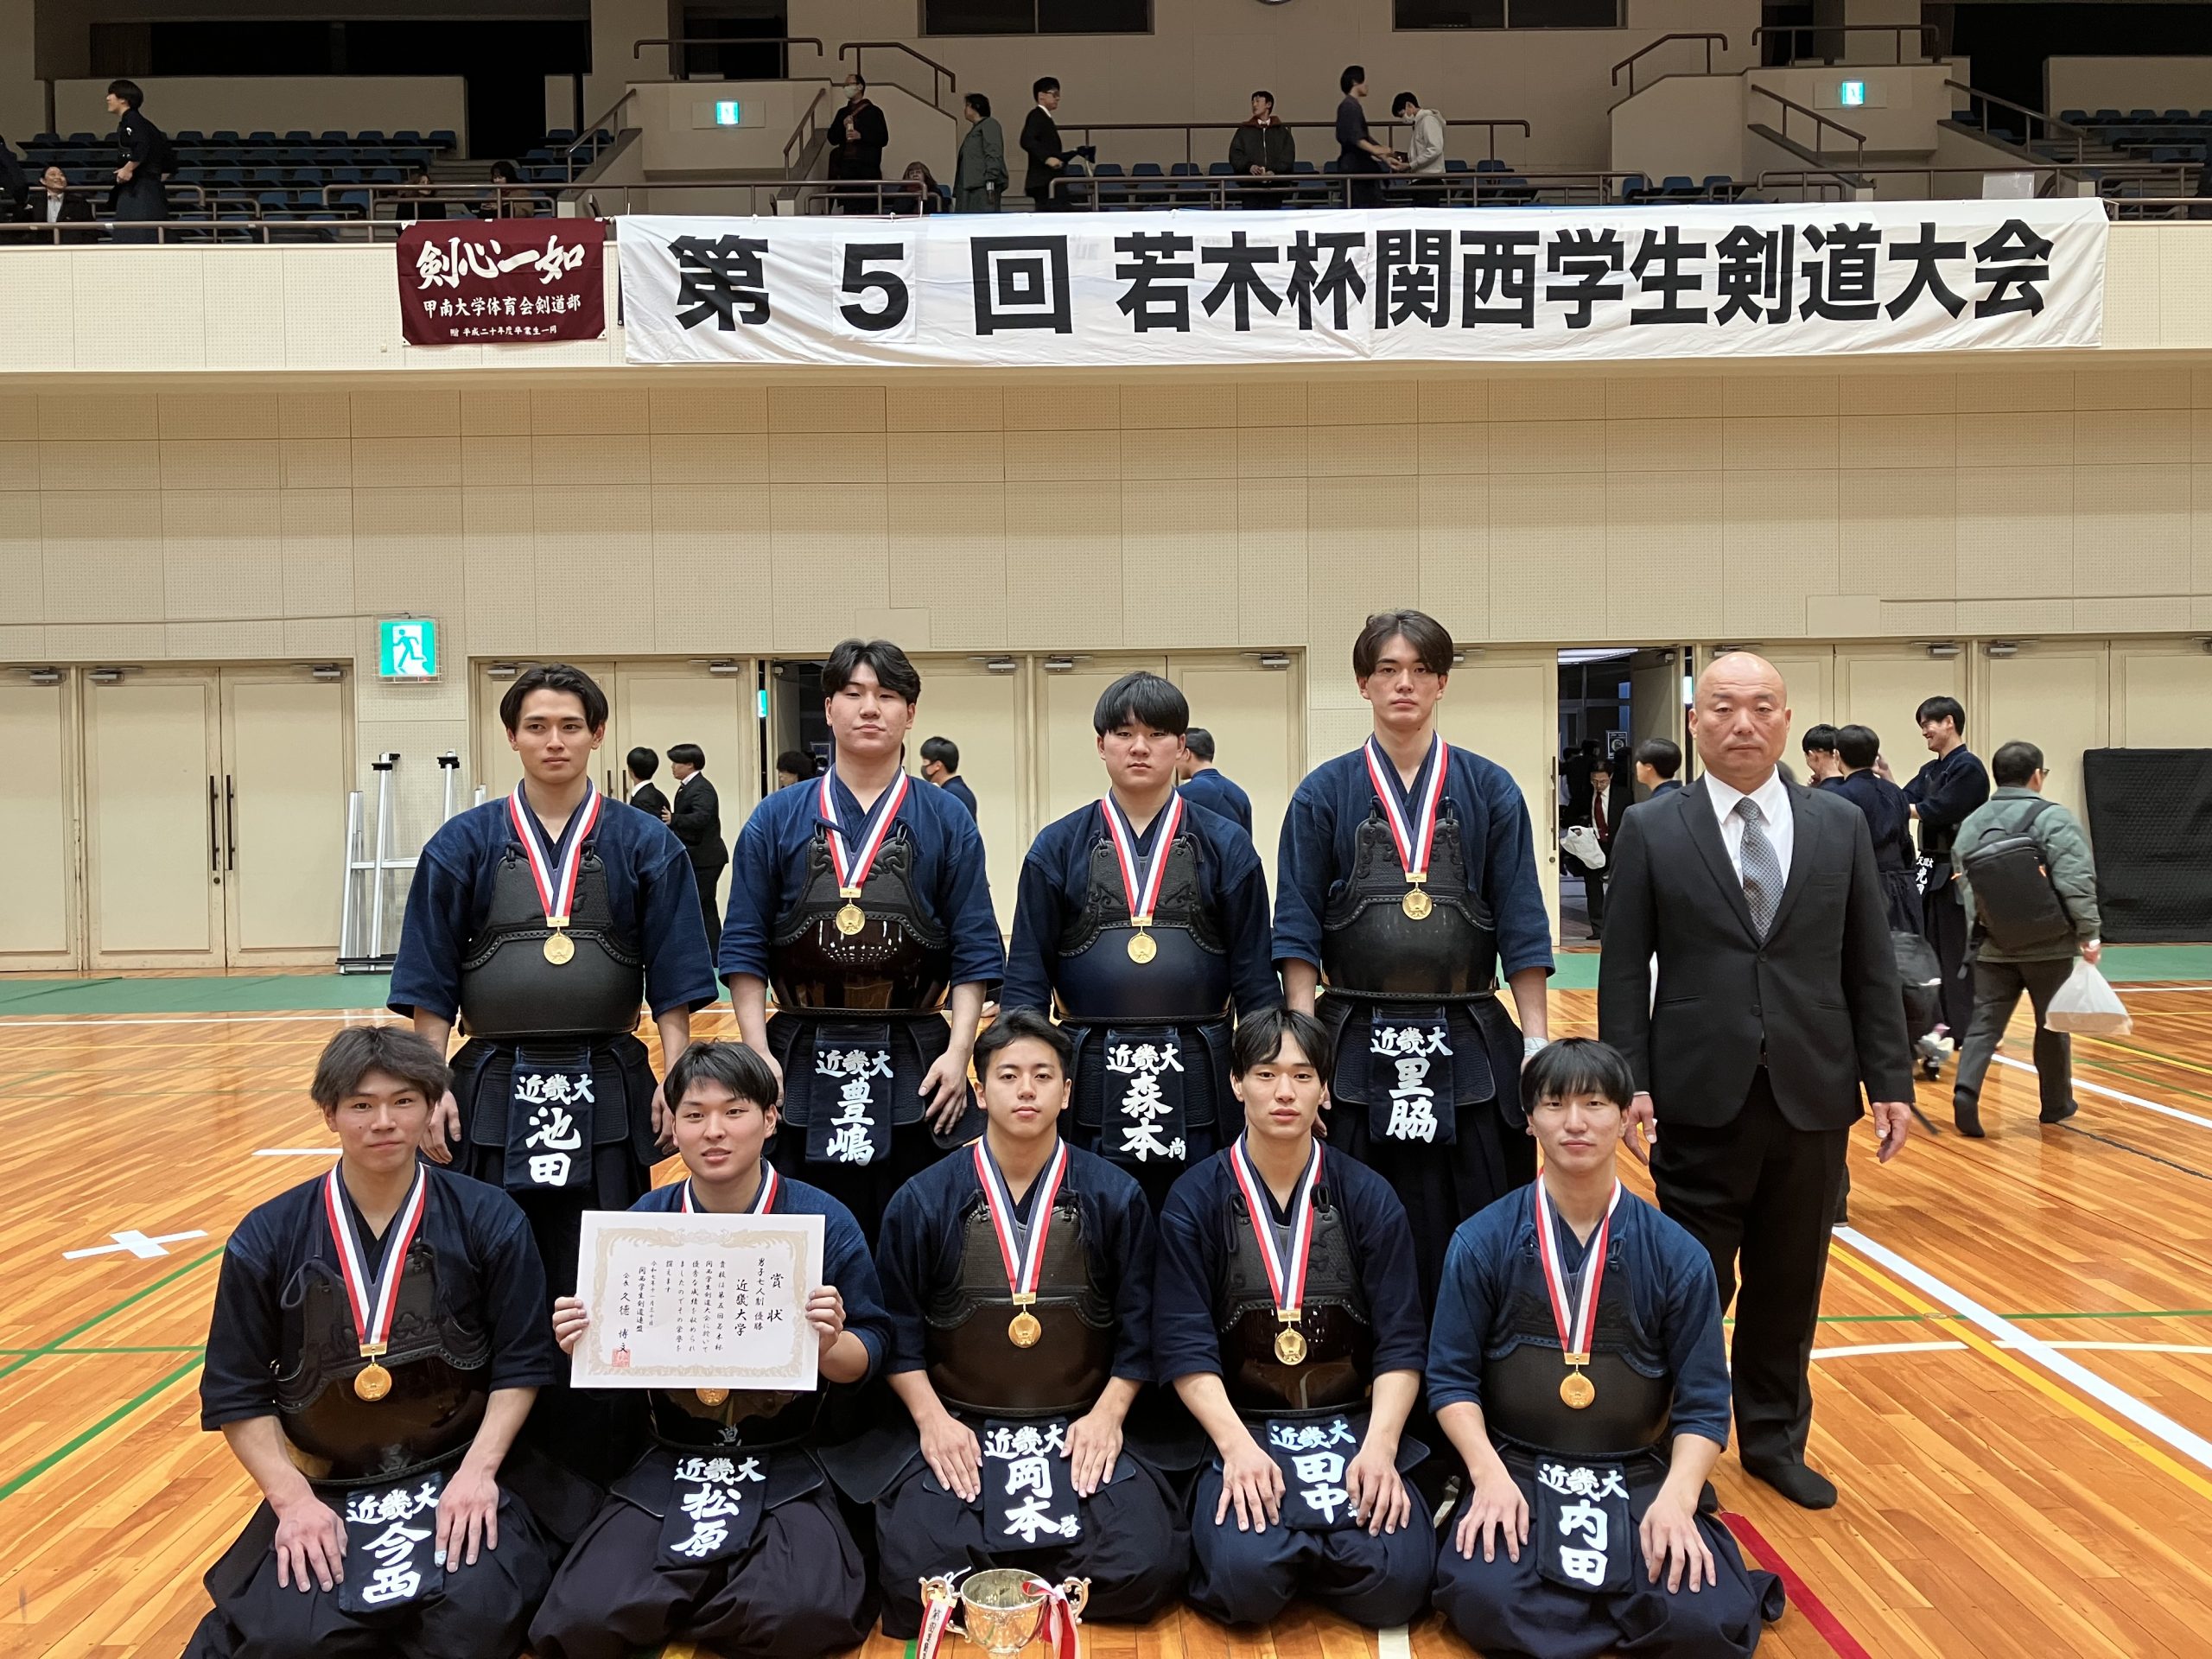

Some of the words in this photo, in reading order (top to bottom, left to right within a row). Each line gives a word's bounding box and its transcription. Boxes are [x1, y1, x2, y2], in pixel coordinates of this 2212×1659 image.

[416, 234, 586, 290] 剣心一如
[1115, 219, 2055, 334] 若木杯関西学生剣道大会
[423, 293, 582, 320] 甲南大学体育会剣道部
[815, 1049, 894, 1080] 近畿大
[1105, 1043, 1185, 1076] 近畿大
[1370, 1026, 1454, 1058] 近畿大
[514, 1073, 595, 1105] 近畿大
[1385, 1057, 1439, 1143] 里脇
[1119, 1071, 1174, 1162] 森本
[525, 1106, 582, 1186] 池田
[734, 1279, 749, 1337] 近畿大学
[767, 1273, 785, 1322] 賞状
[983, 1423, 1065, 1460] 近畿大
[1269, 1419, 1357, 1452] 近畿大
[673, 1457, 766, 1486] 近畿大
[1291, 1451, 1350, 1525] 田中
[1537, 1463, 1630, 1503] 近畿大
[346, 1482, 440, 1525] 近畿大
[670, 1482, 742, 1558] 松原
[1003, 1456, 1062, 1543] 岡本
[361, 1521, 432, 1604] 今西
[1558, 1498, 1609, 1586] 内田
